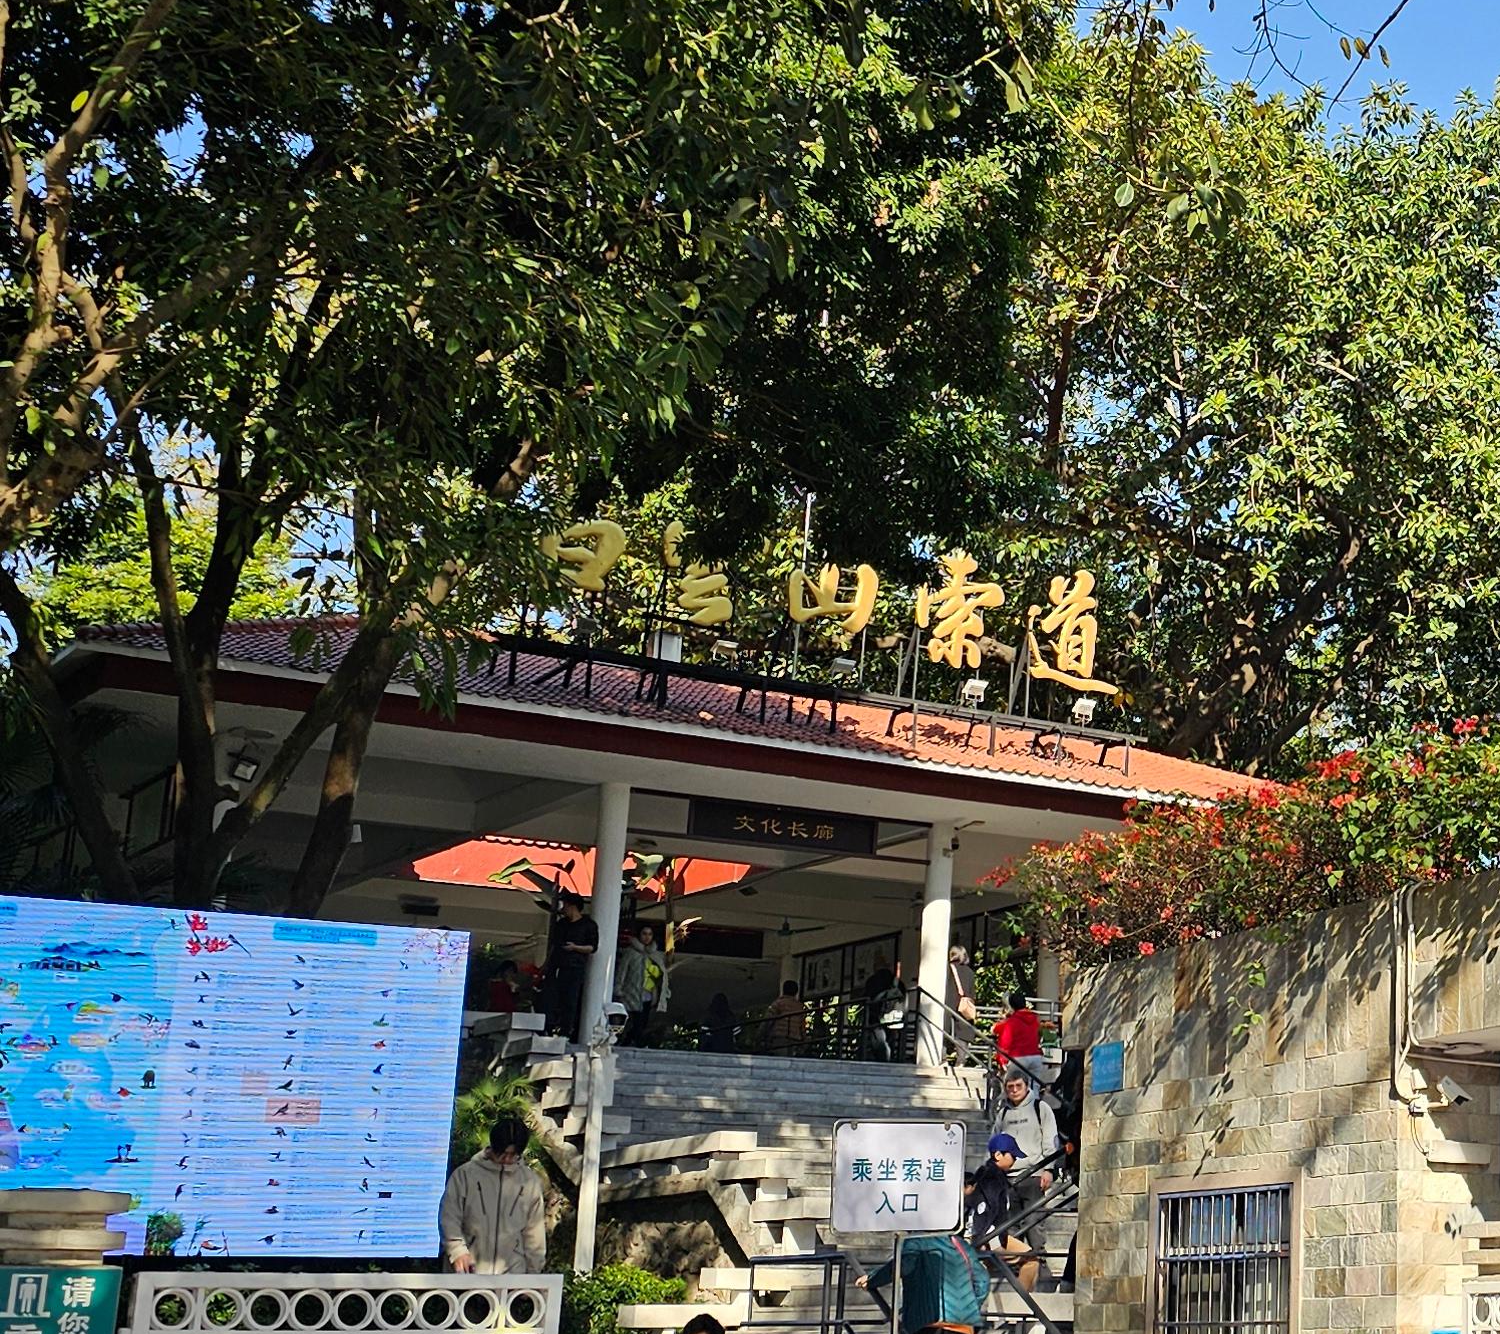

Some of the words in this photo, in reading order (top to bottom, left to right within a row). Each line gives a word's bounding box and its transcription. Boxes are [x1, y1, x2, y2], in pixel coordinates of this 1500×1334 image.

[733, 816, 834, 840] 文化长廊
[852, 1158, 946, 1182] 乘坐索道
[875, 1191, 919, 1214] 入口
